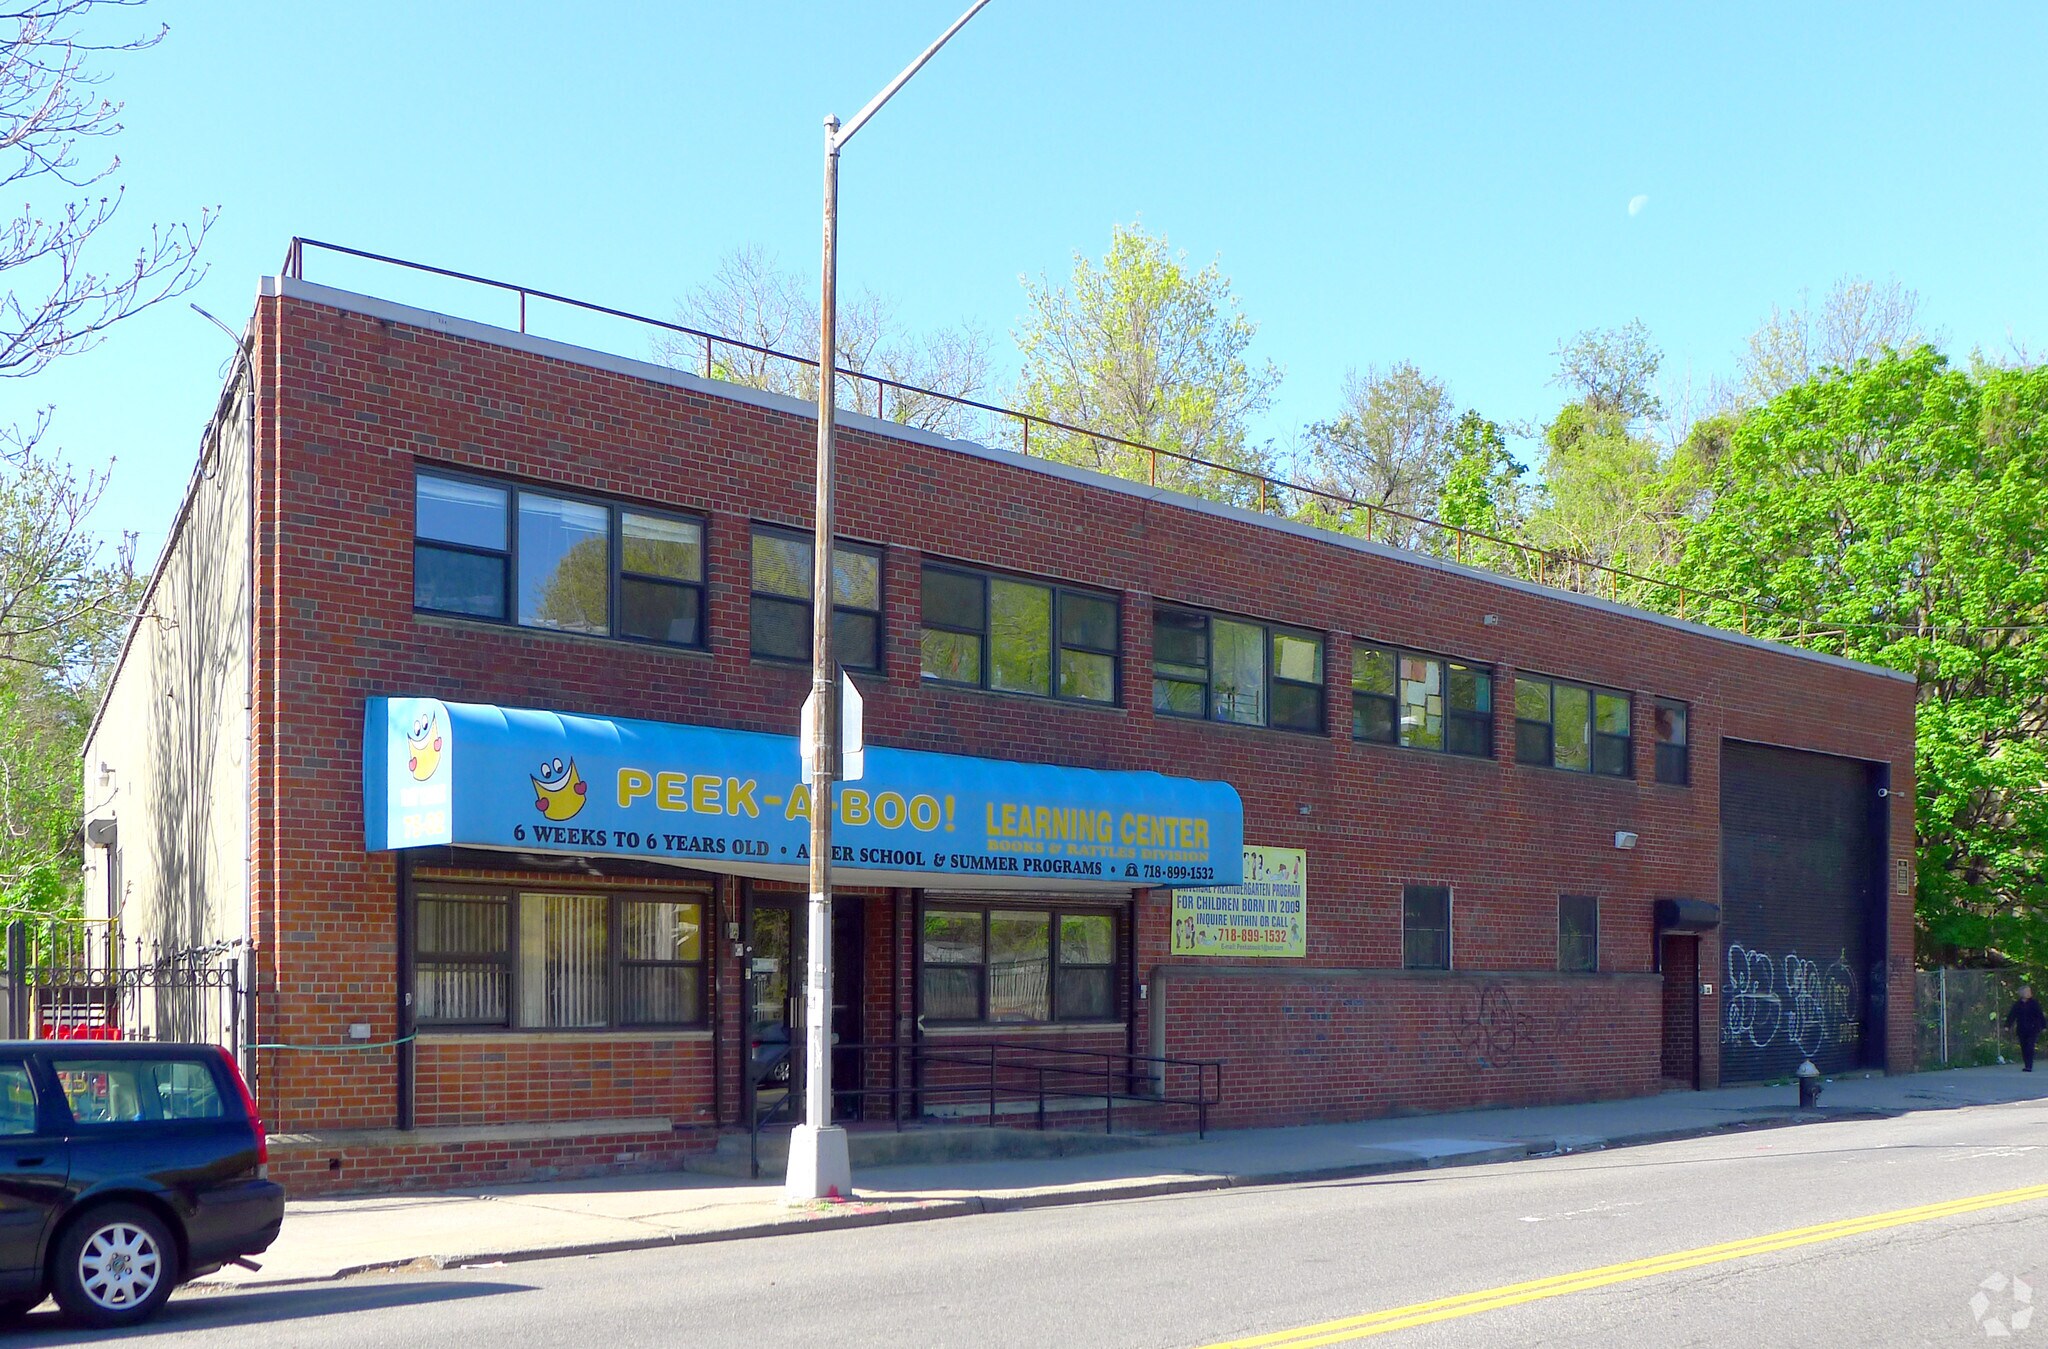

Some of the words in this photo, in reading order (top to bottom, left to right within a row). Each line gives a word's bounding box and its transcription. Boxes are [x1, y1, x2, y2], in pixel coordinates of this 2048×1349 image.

[617, 767, 955, 832] PEEK-ABOO!
[986, 802, 1113, 843] LEARNING
[1119, 812, 1209, 849] CENTER
[513, 824, 525, 841] 6
[532, 825, 607, 847] WEEKS
[613, 831, 640, 848] TO
[646, 833, 657, 850] 6
[662, 834, 726, 854] YEARS
[731, 839, 770, 856] OLD
[796, 843, 854, 862] AER
[859, 847, 926, 866] SCHOOL
[933, 852, 946, 868] &
[950, 853, 1019, 872] SUMMER
[1022, 857, 1102, 875] PROGRAMS
[987, 839, 1044, 854] BOOKS
[1067, 844, 1136, 859] RATTLES
[1141, 848, 1209, 862] DIVISION
[1272, 884, 1301, 898] PROGRAM
[1177, 895, 1194, 909] FOR
[1196, 895, 1239, 912] CHILDREN
[1242, 899, 1265, 913] BORN
[1267, 899, 1278, 913] IN
[1279, 900, 1300, 914] 2009
[1196, 913, 1228, 928] INQUIRE
[1229, 914, 1258, 927] WITHIN
[1259, 916, 1270, 927] OR
[1271, 916, 1288, 928] CALL
[1218, 928, 1287, 943] 718-899-1532
